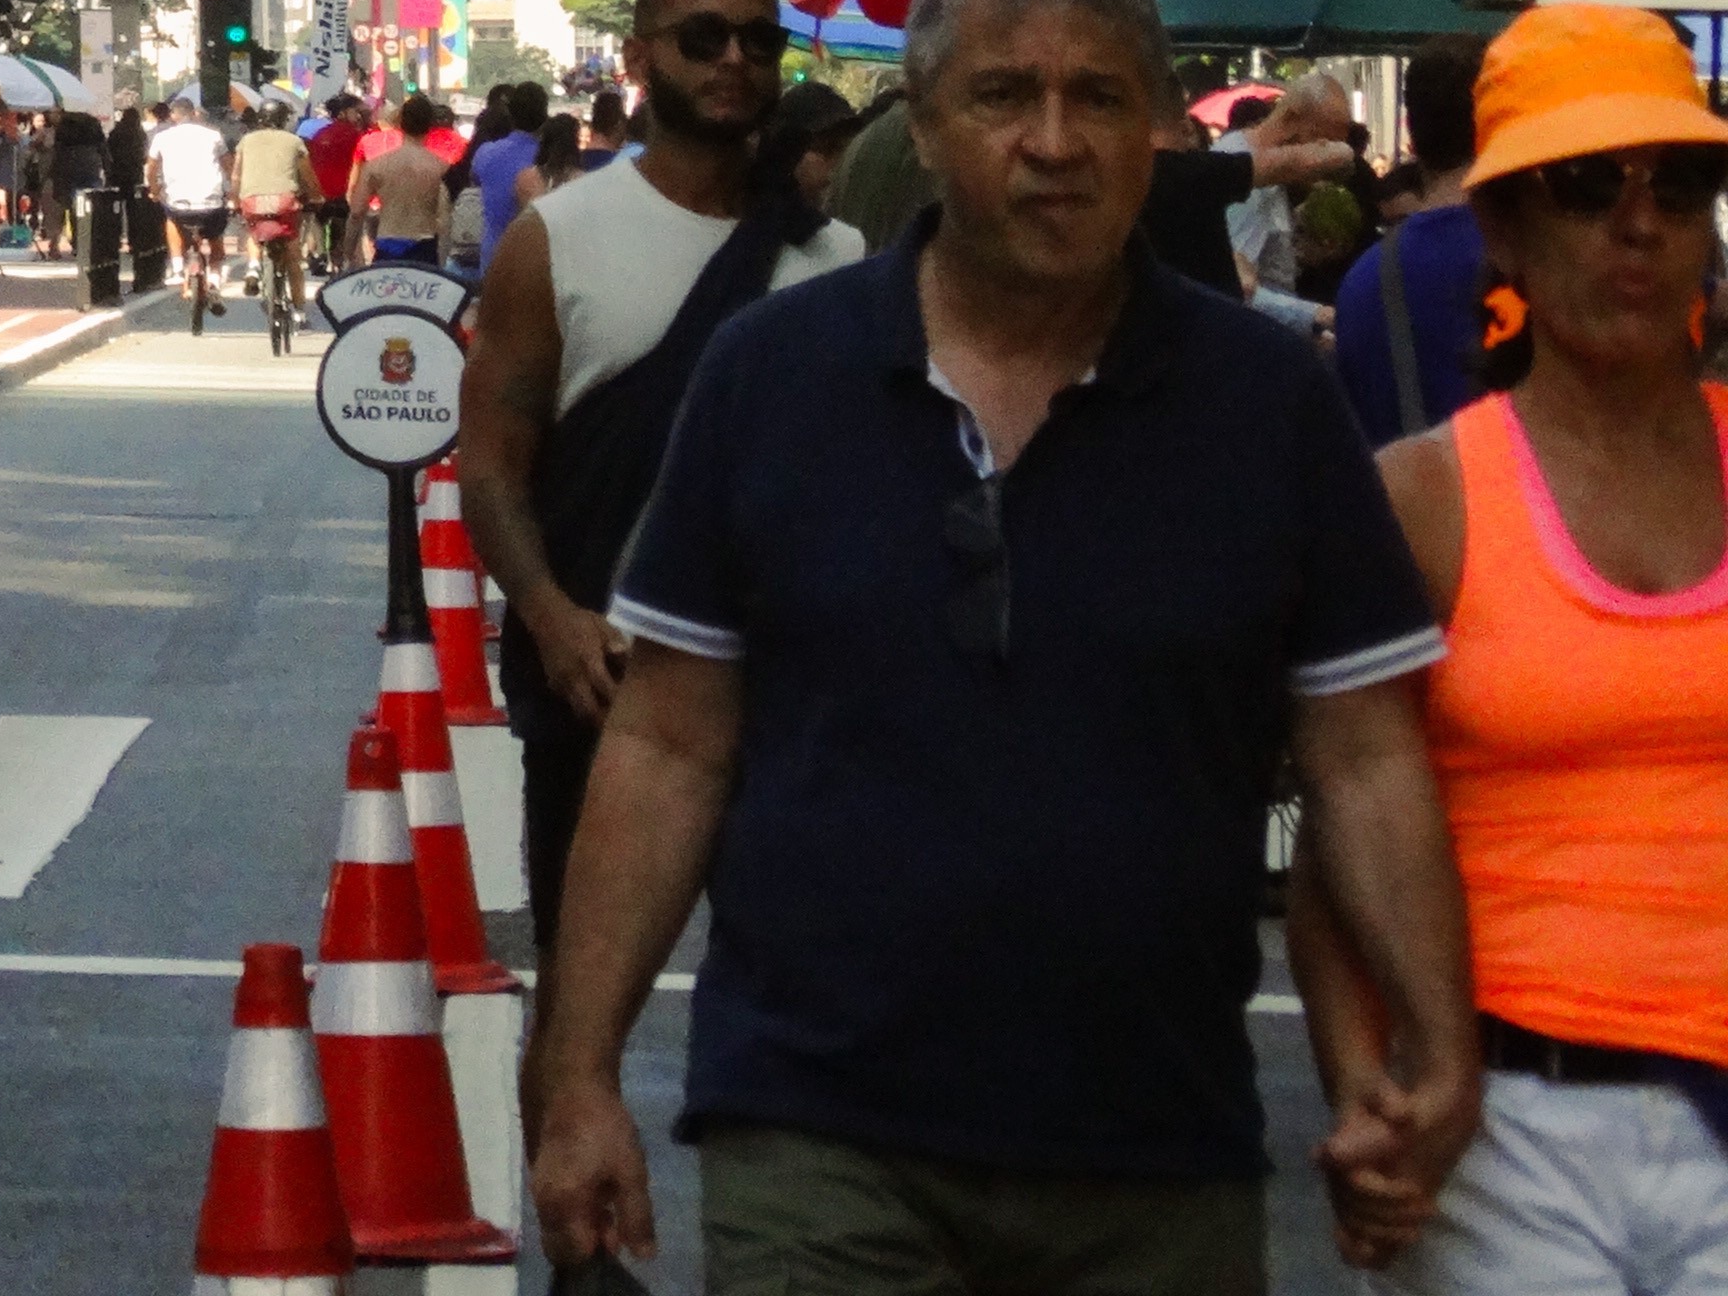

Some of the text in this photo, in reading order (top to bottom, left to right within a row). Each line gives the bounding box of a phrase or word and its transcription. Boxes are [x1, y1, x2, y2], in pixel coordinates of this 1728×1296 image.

[353, 388, 439, 404] CIDADE DE
[341, 400, 452, 423] SÃO PAULO
